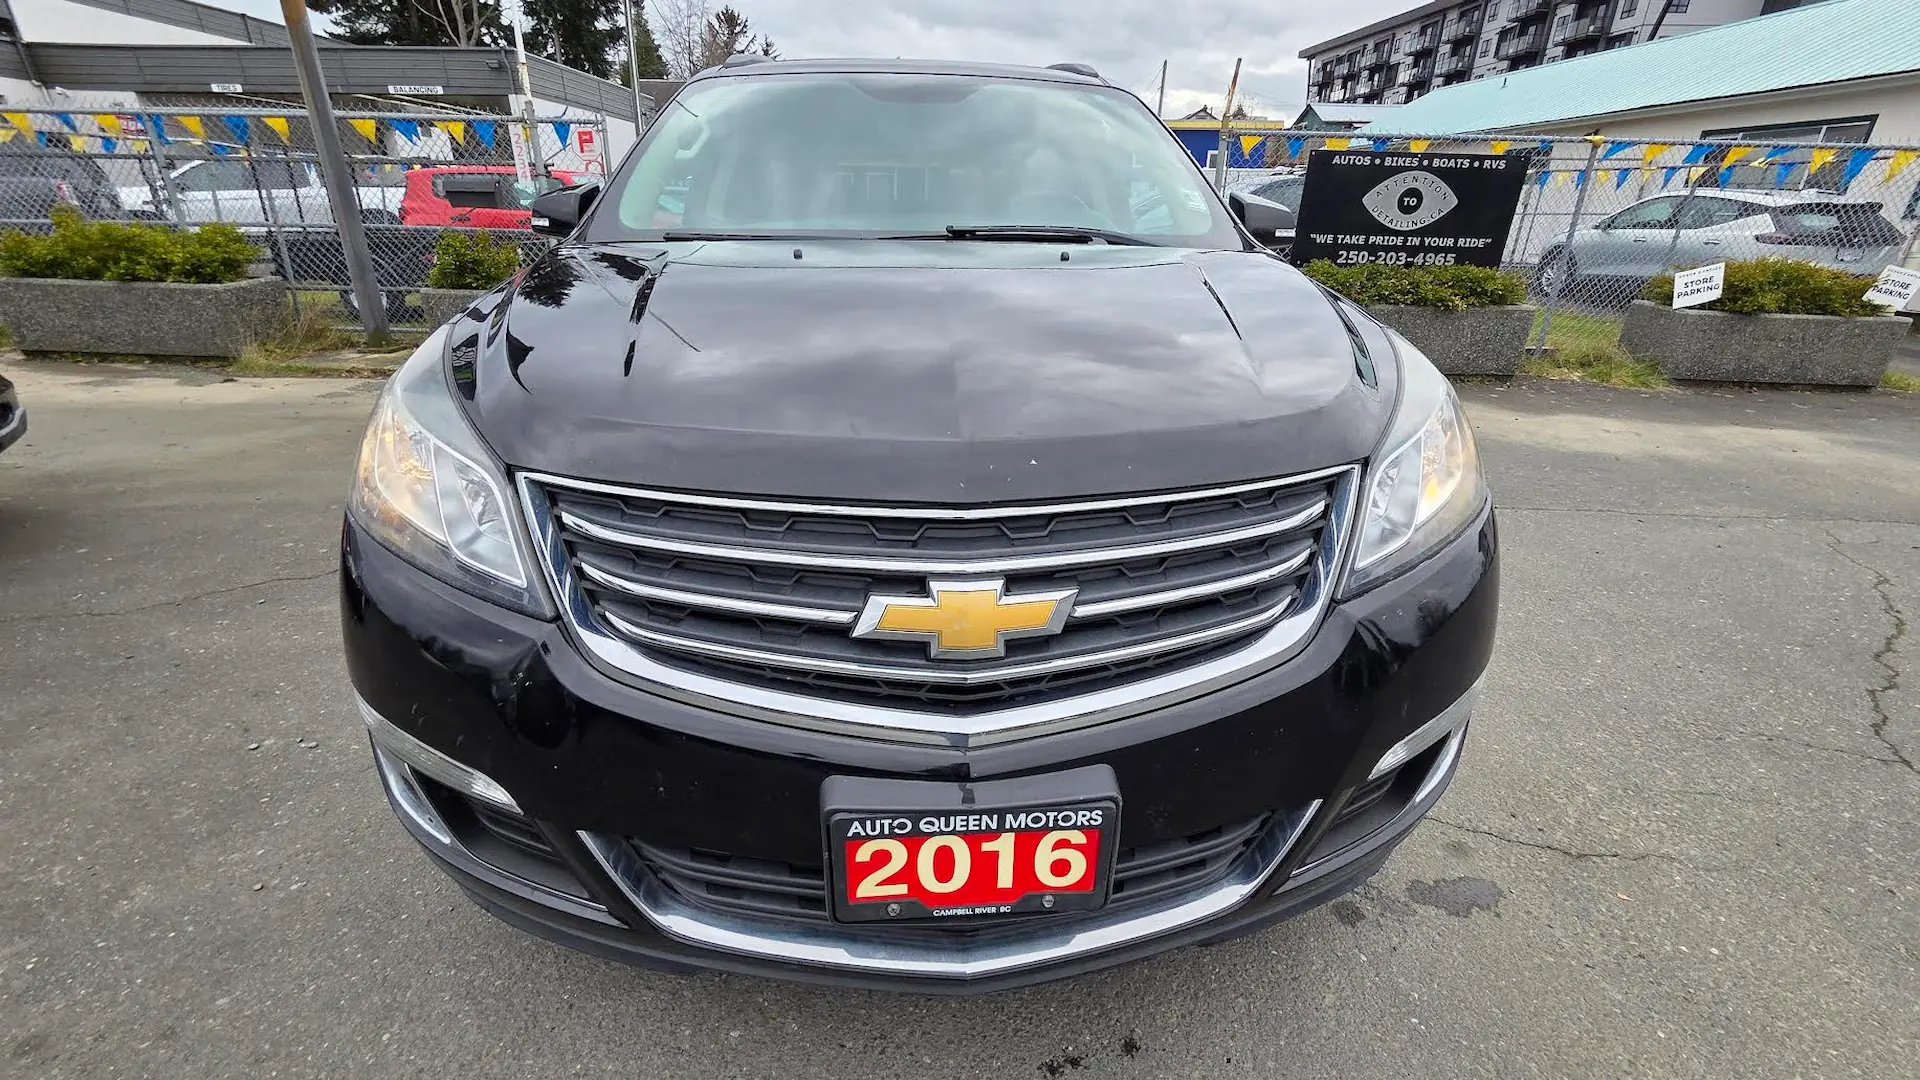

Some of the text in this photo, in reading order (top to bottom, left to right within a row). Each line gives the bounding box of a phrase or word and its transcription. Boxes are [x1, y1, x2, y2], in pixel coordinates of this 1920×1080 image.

[216, 84, 238, 92] TIRES
[1332, 155, 1507, 170] AUTOS BIKES BOATS RVS
[1376, 175, 1449, 200] ATTENTION
[1403, 197, 1418, 206] TO
[1371, 205, 1444, 228] DETAILING.CA
[1337, 234, 1366, 245] TAKE
[1368, 235, 1404, 246] PRIDE
[1406, 236, 1421, 246] IN
[1424, 237, 1454, 247] YOUR
[1336, 250, 1456, 265] 250-203-4965
[1683, 275, 1714, 289] STORE
[1883, 278, 1911, 290] STORE
[1677, 283, 1720, 299] PARKING
[1871, 284, 1910, 300] PARKING
[847, 809, 1103, 837] AUTO QUEEN MOTORS
[855, 829, 1088, 899] 2016
[932, 905, 1012, 917] CAMPBELL RIVER BC
